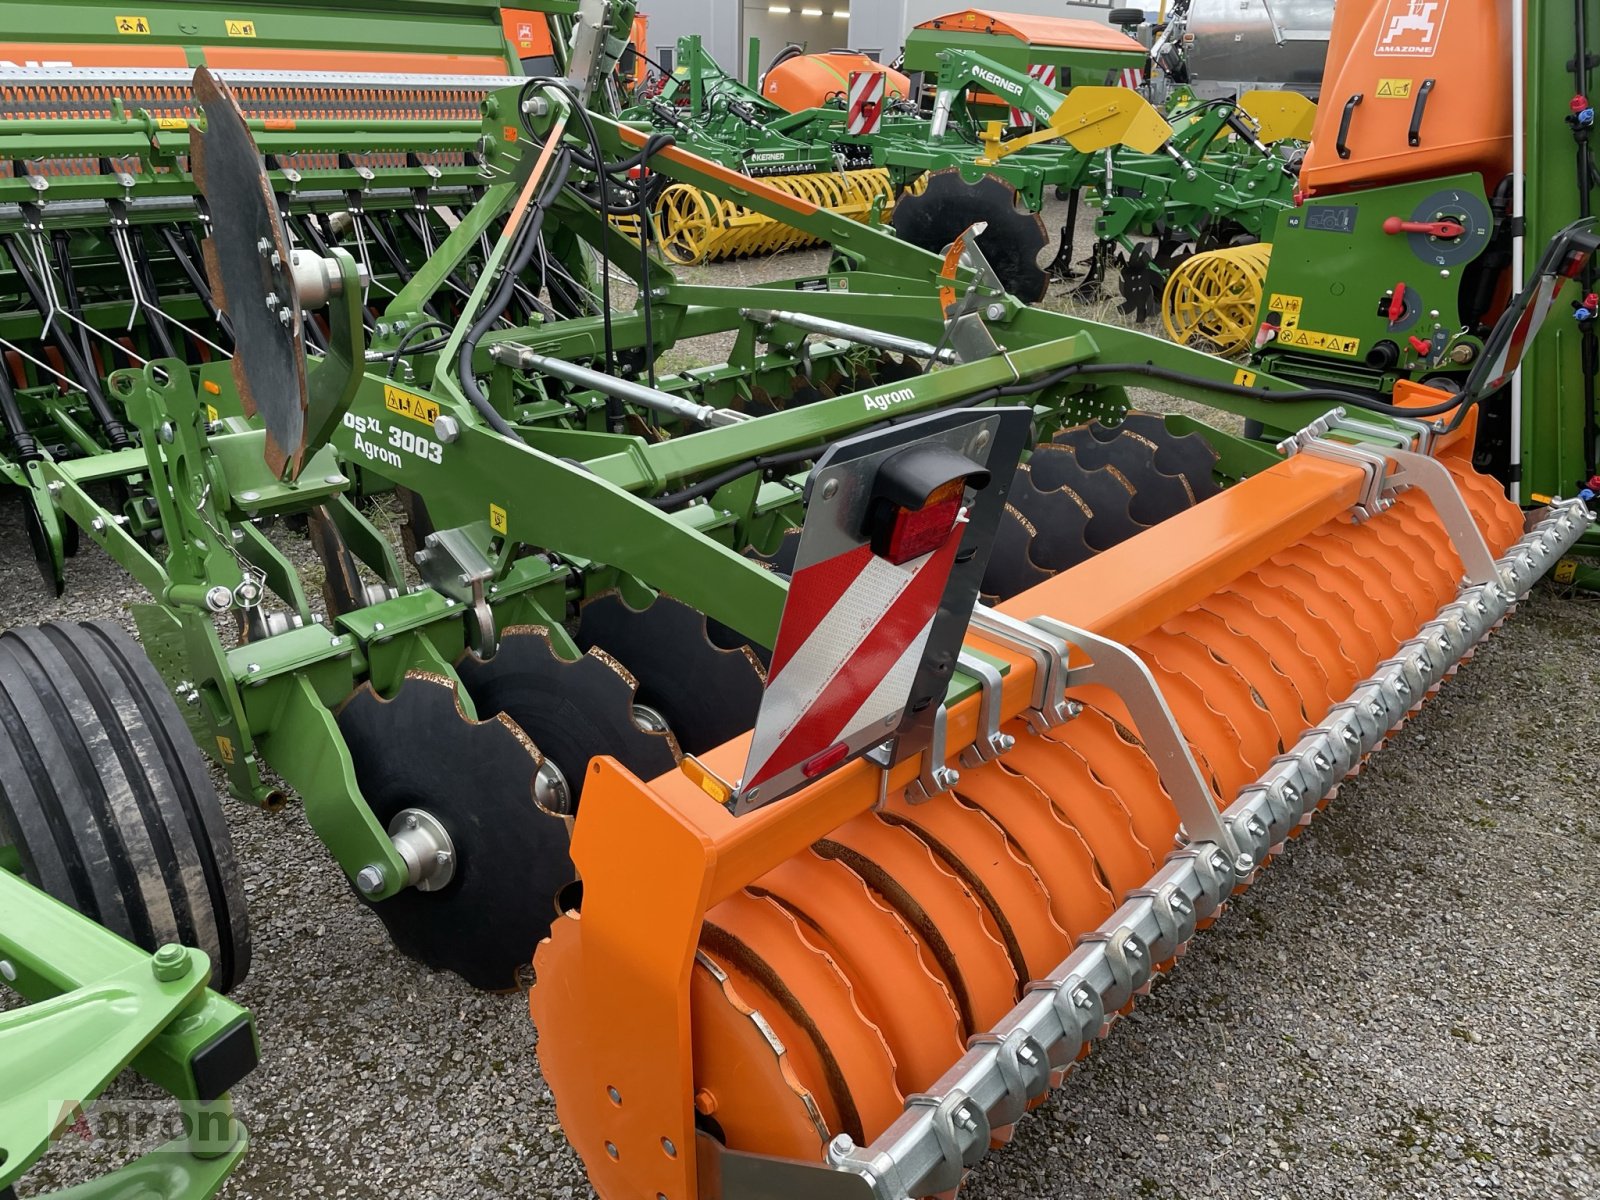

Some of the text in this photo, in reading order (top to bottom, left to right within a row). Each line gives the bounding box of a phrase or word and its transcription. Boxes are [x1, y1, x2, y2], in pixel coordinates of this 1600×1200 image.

[892, 51, 905, 70] JC
[977, 67, 1024, 96] KERNER
[756, 152, 785, 161] KERNER
[863, 388, 915, 411] Agrom
[354, 432, 402, 468] Agrom
[388, 425, 443, 465] 3003
